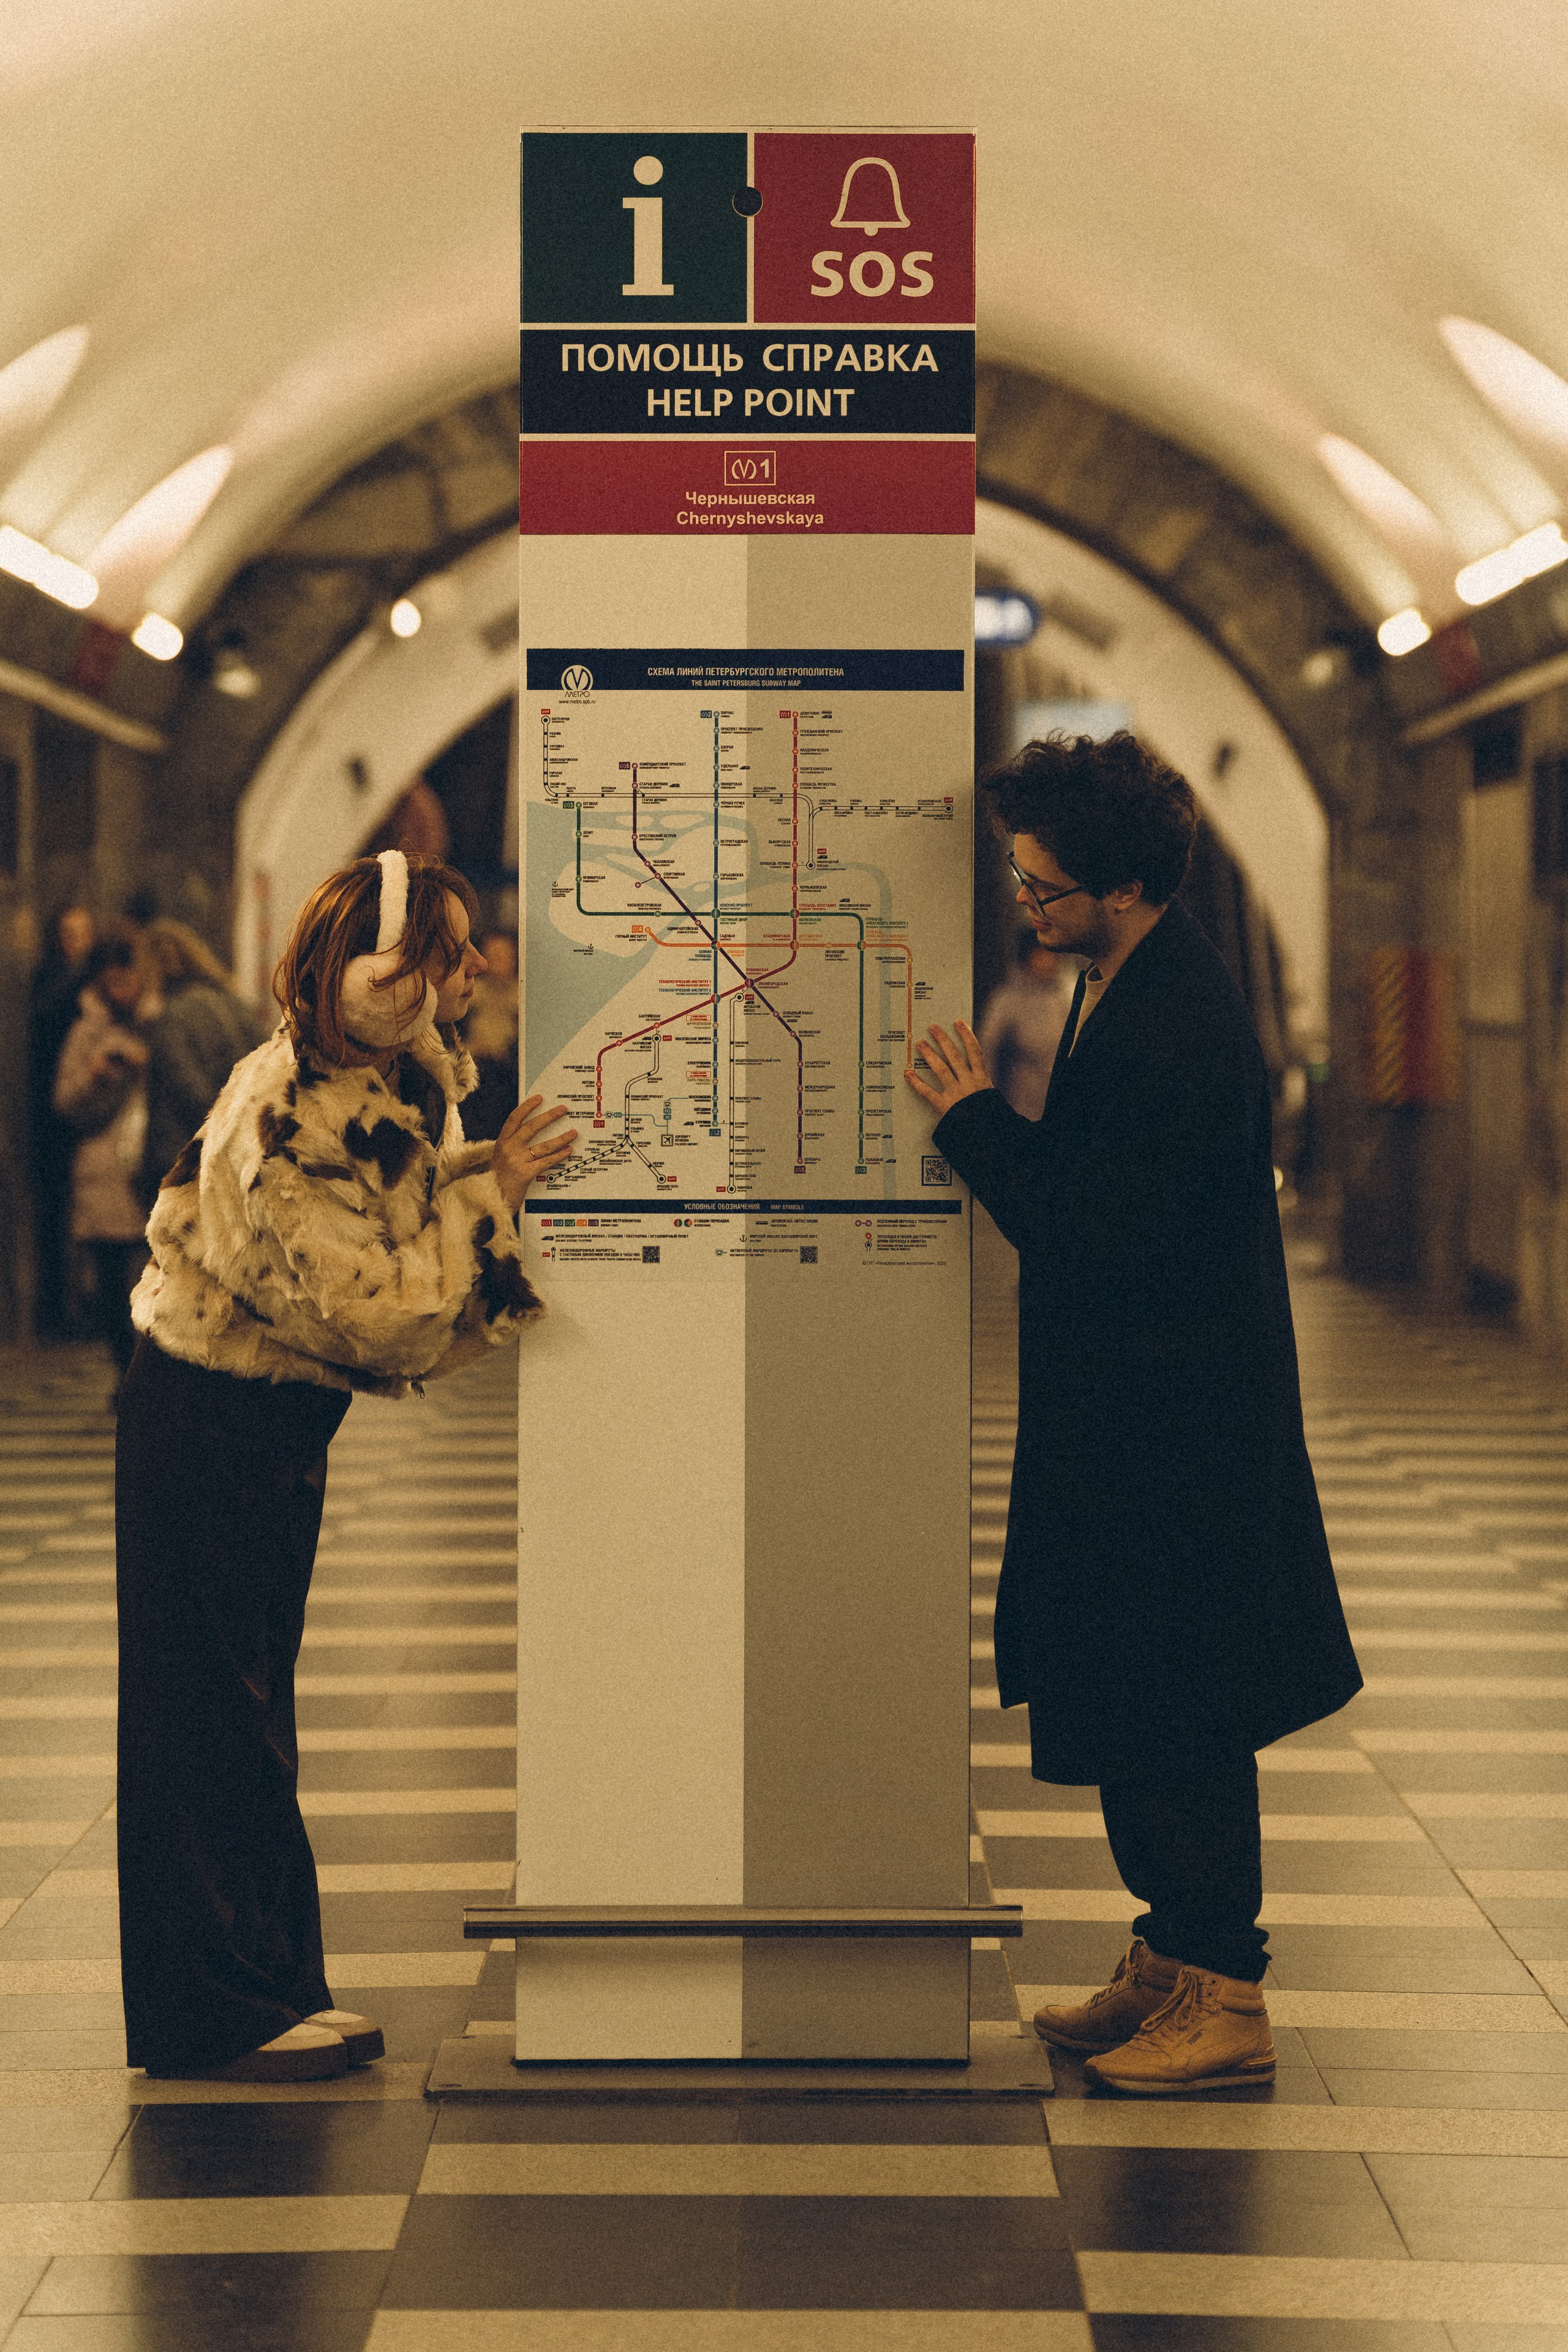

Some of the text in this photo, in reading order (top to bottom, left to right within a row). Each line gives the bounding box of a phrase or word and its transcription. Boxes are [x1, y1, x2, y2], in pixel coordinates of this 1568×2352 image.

[810, 251, 934, 297] SOS
[562, 344, 938, 377] ПОМОЩЬ СПРАВКА
[647, 389, 854, 417] HELP POINT
[685, 491, 816, 507] Чернышевская
[677, 510, 824, 529] Chernyshevskaya
[647, 666, 844, 676] СХЕМА ЛИНИЙ ПЕТЕРБУРГСКОГО МЕТРОПОЛИТЕНА
